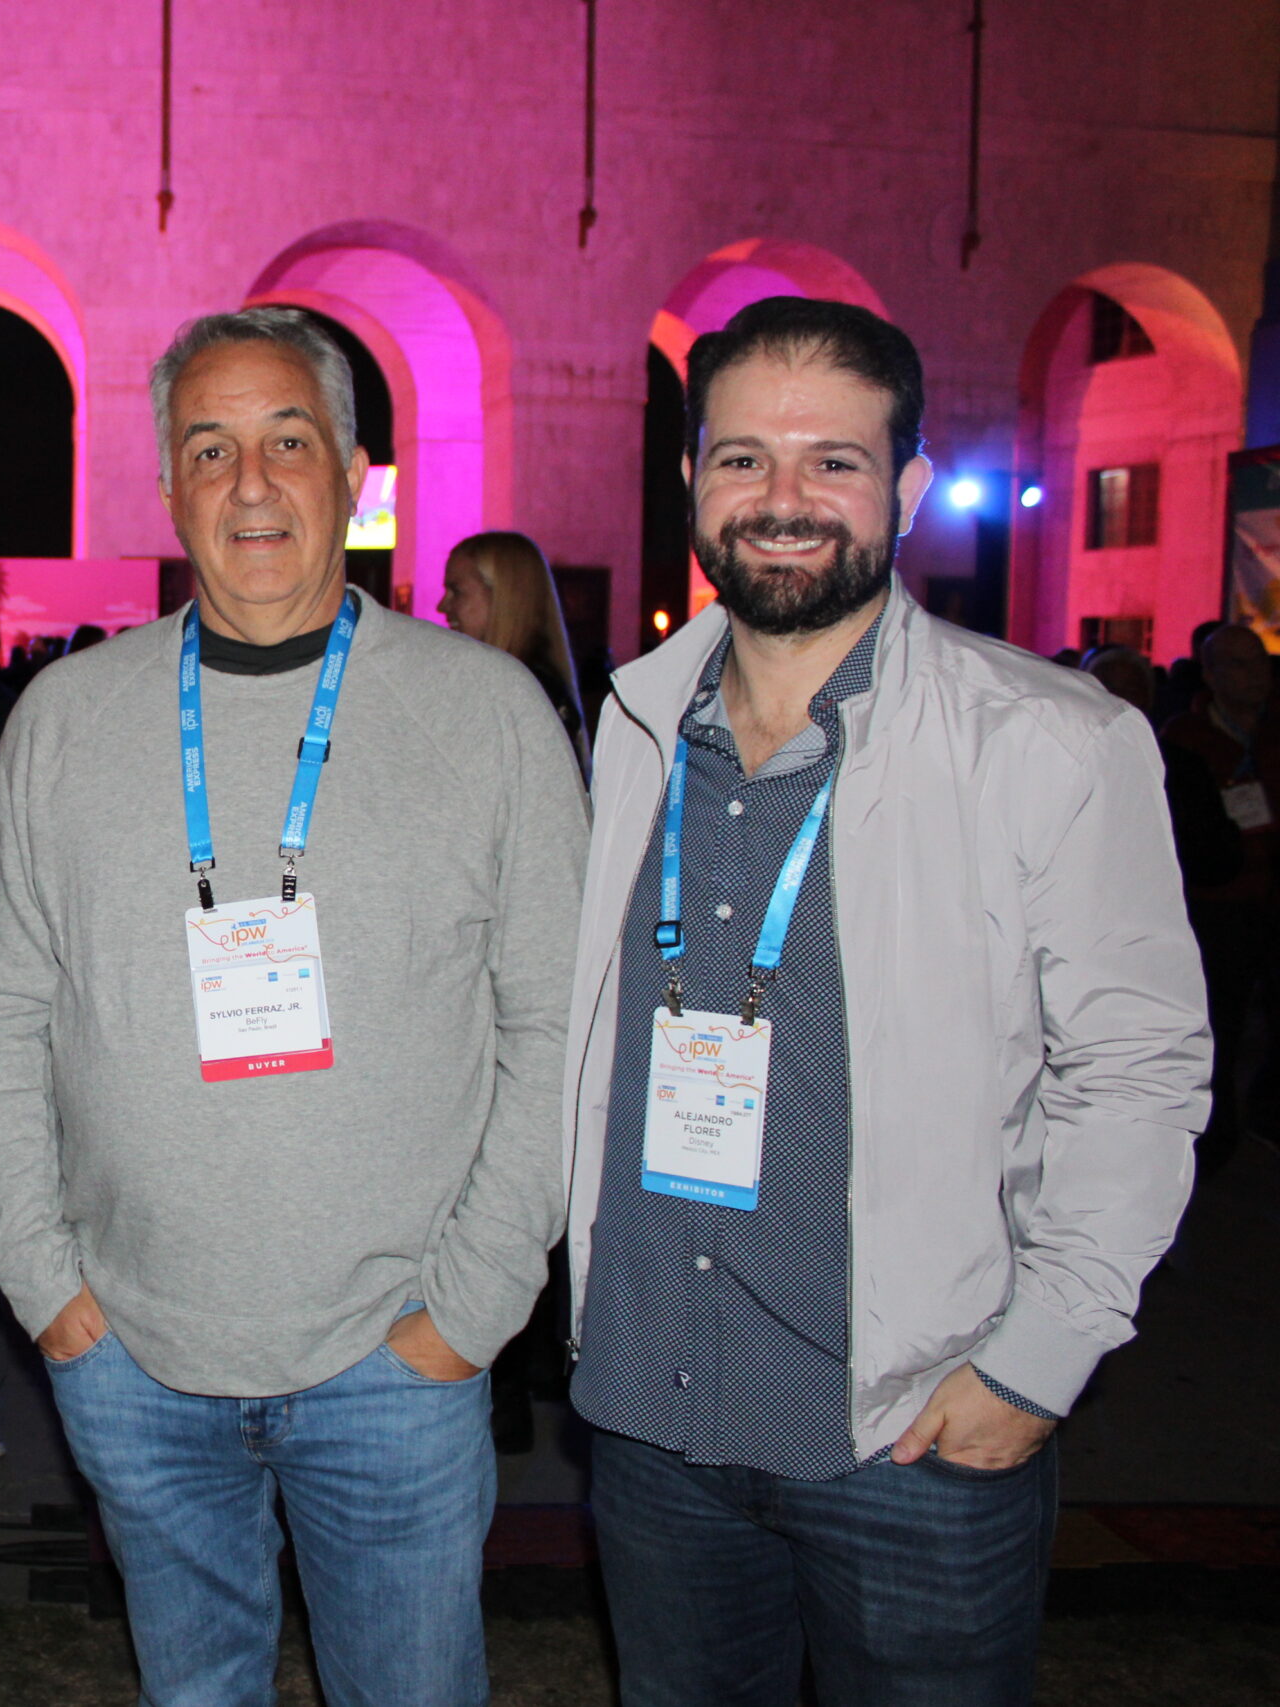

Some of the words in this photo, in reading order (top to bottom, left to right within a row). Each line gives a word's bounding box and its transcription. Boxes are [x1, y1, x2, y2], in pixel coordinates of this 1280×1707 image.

[182, 654, 190, 692] AMERICAN
[322, 654, 337, 689] EXPRESS
[329, 651, 345, 691] AMERICAN
[185, 747, 195, 792] AMERICAN
[192, 746, 201, 786] EXPRESS
[231, 926, 267, 946] ipw
[202, 954, 231, 964] Bringing
[245, 950, 266, 958] World
[201, 980, 223, 992] ipw
[210, 1009, 243, 1020] SYLVIO
[245, 1004, 286, 1015] FERRAZ,
[288, 1002, 302, 1011] JR.
[246, 1017, 268, 1026] BeFly
[689, 1041, 722, 1059] ipw
[248, 1060, 285, 1070] BUYER
[698, 1068, 717, 1076] World
[674, 1110, 733, 1126] ALEJANDRO
[683, 1124, 721, 1137] FLORES
[670, 1181, 725, 1198] EXHIBITOR
